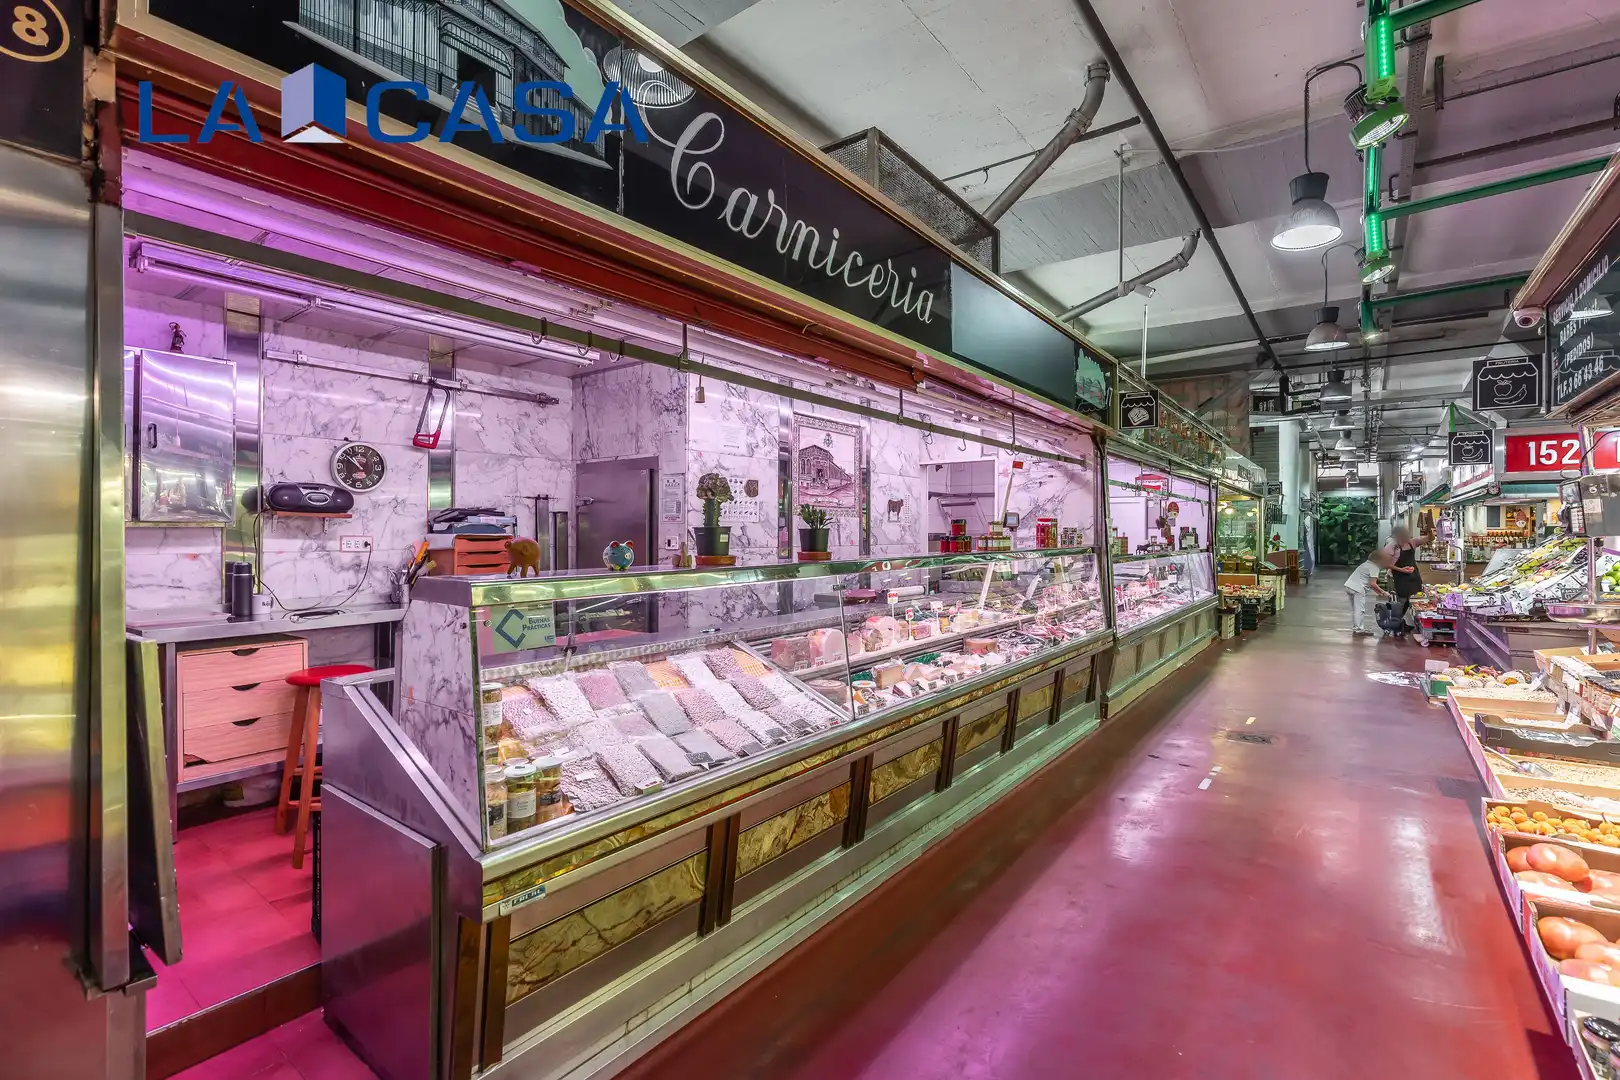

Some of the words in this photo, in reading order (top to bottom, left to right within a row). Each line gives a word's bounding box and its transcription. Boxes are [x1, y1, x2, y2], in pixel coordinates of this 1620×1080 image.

[12, 5, 49, 46] 8
[1579, 254, 1609, 298] DOMICILIO
[1559, 319, 1577, 347] BARES
[1564, 331, 1594, 368] (PEDIDOS)
[1527, 439, 1580, 466] 152
[528, 617, 550, 625] BUENAS
